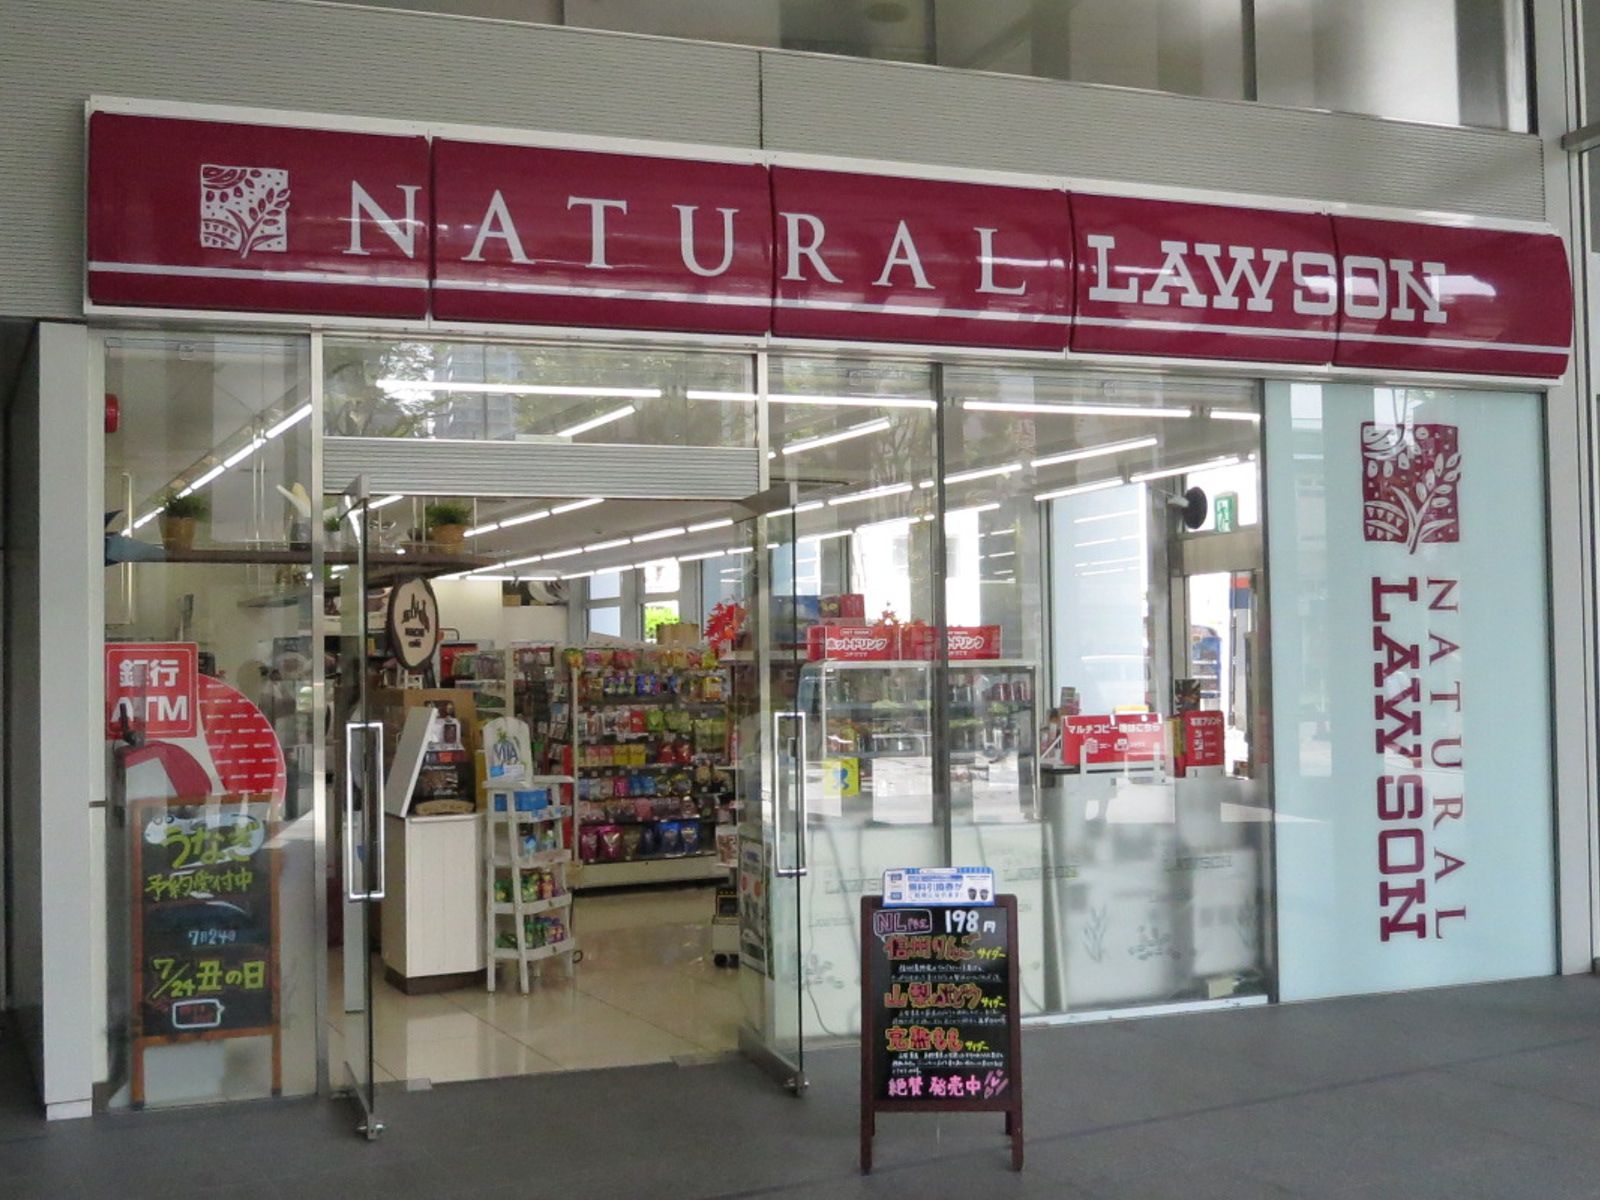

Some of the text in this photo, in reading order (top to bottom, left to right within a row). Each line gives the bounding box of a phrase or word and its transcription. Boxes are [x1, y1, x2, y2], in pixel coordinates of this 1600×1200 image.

[342, 180, 1449, 325] NATURAL LAWSON
[110, 695, 188, 722] ATM
[1371, 576, 1427, 943] LAWSON
[1426, 577, 1467, 939] NATURAL
[144, 867, 254, 901] 予約受付中
[161, 821, 261, 869] うなぎ
